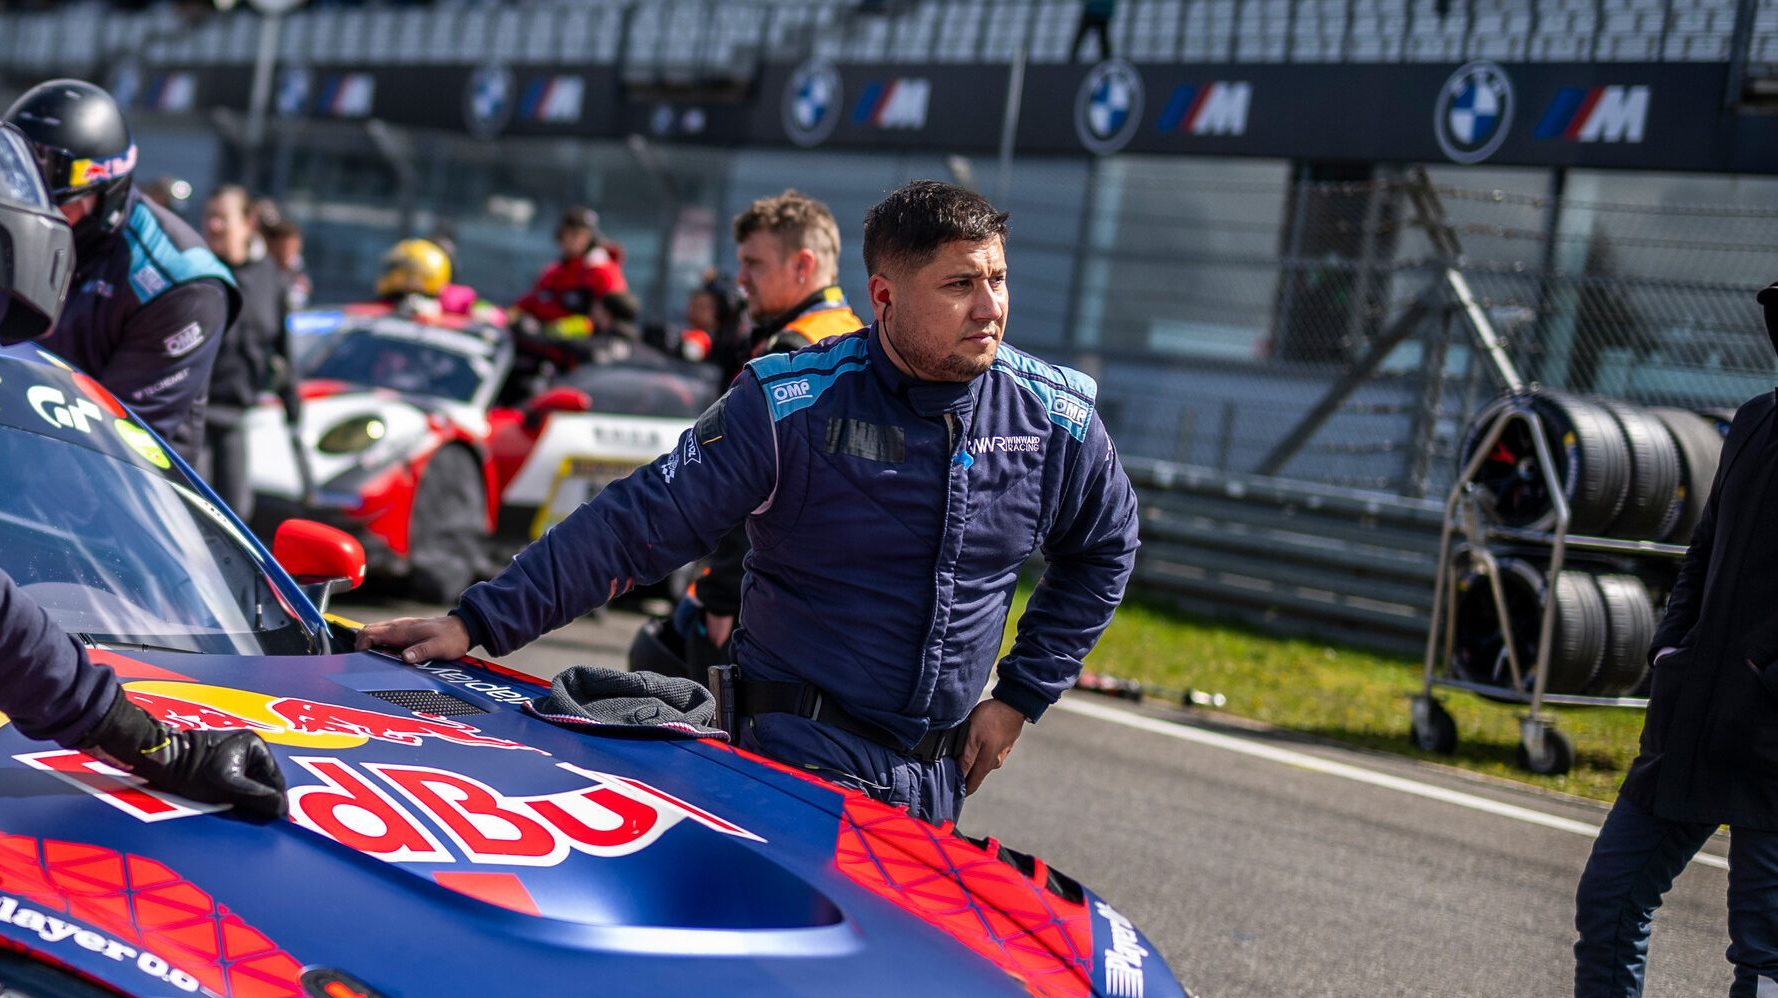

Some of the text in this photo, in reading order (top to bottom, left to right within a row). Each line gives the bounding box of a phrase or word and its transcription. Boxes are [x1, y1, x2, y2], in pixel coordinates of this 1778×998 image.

[1192, 81, 1253, 136] M
[1577, 84, 1652, 142] M
[165, 326, 202, 354] OMP
[773, 381, 811, 401] OMP
[1053, 398, 1088, 424] OMP
[1005, 443, 1040, 452] RACING
[136, 952, 202, 993] 0.0
